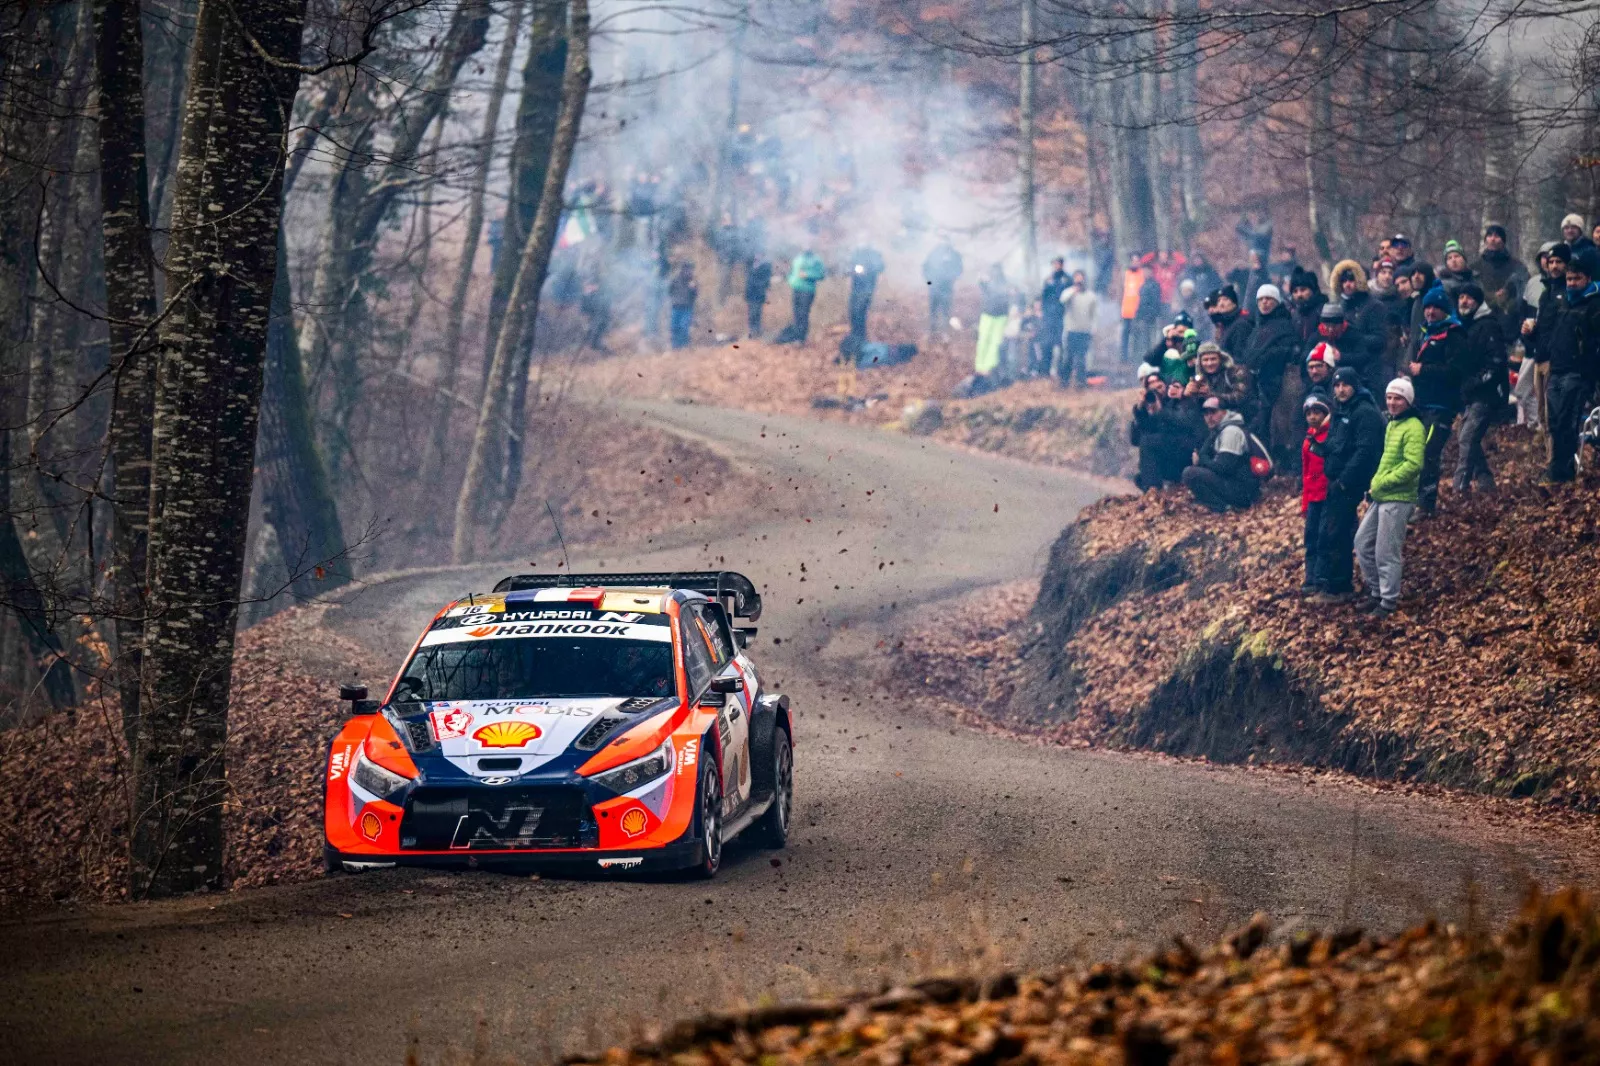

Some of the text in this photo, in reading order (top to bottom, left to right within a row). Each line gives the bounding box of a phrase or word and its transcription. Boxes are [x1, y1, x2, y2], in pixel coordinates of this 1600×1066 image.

[462, 605, 483, 614] 16
[502, 611, 592, 621] HYUNDAI
[483, 706, 594, 718] MOBIS
